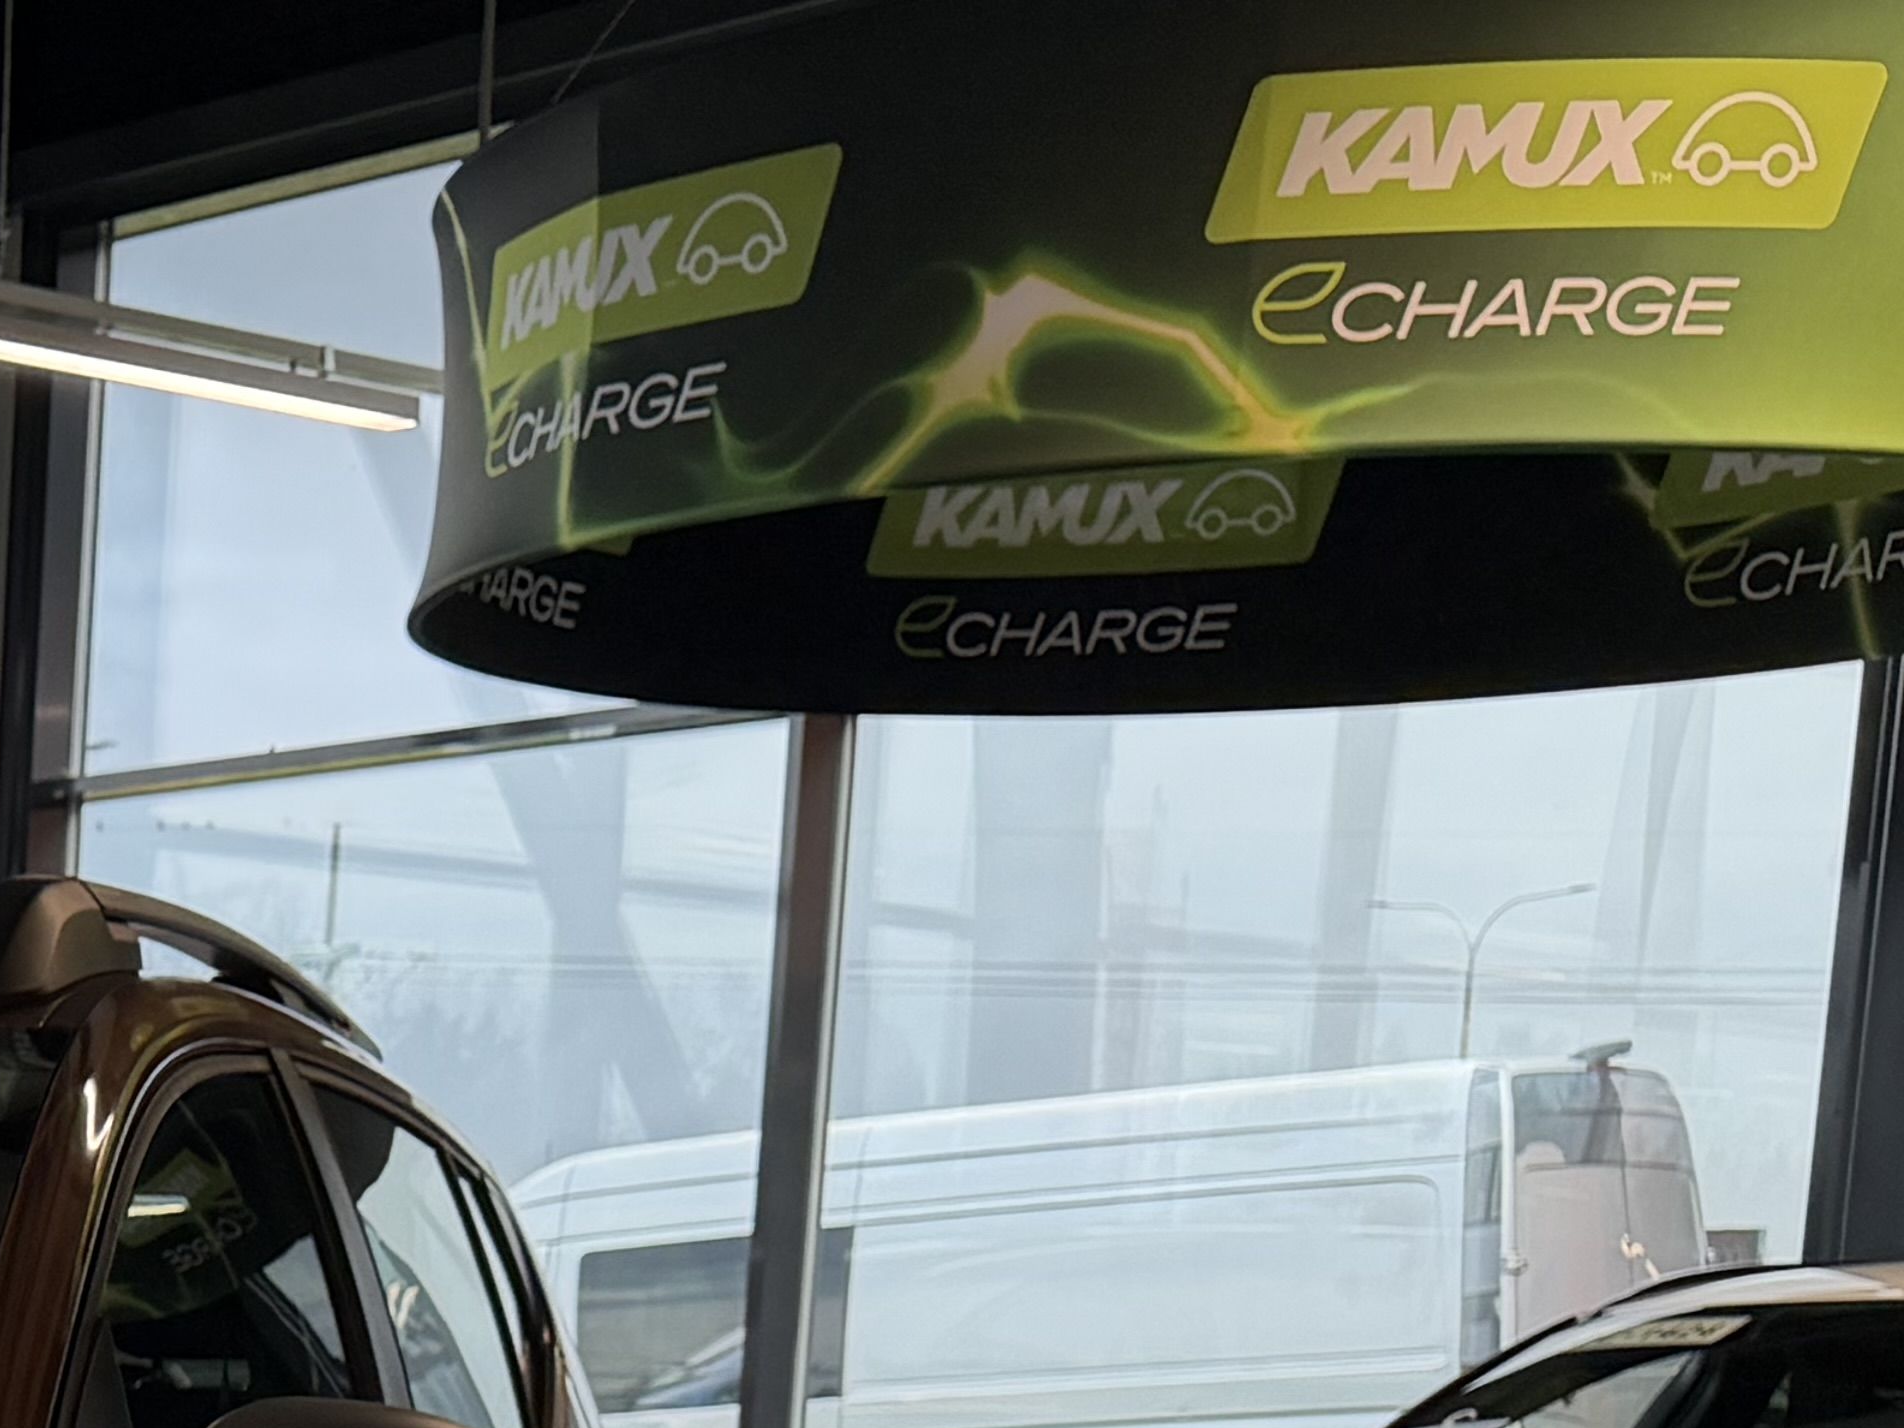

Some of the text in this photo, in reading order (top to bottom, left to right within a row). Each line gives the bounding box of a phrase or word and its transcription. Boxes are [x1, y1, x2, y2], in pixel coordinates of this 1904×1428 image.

[1276, 99, 1674, 198] KAMUX
[499, 214, 673, 351] KAMUX
[912, 479, 1183, 548] KAMUX
